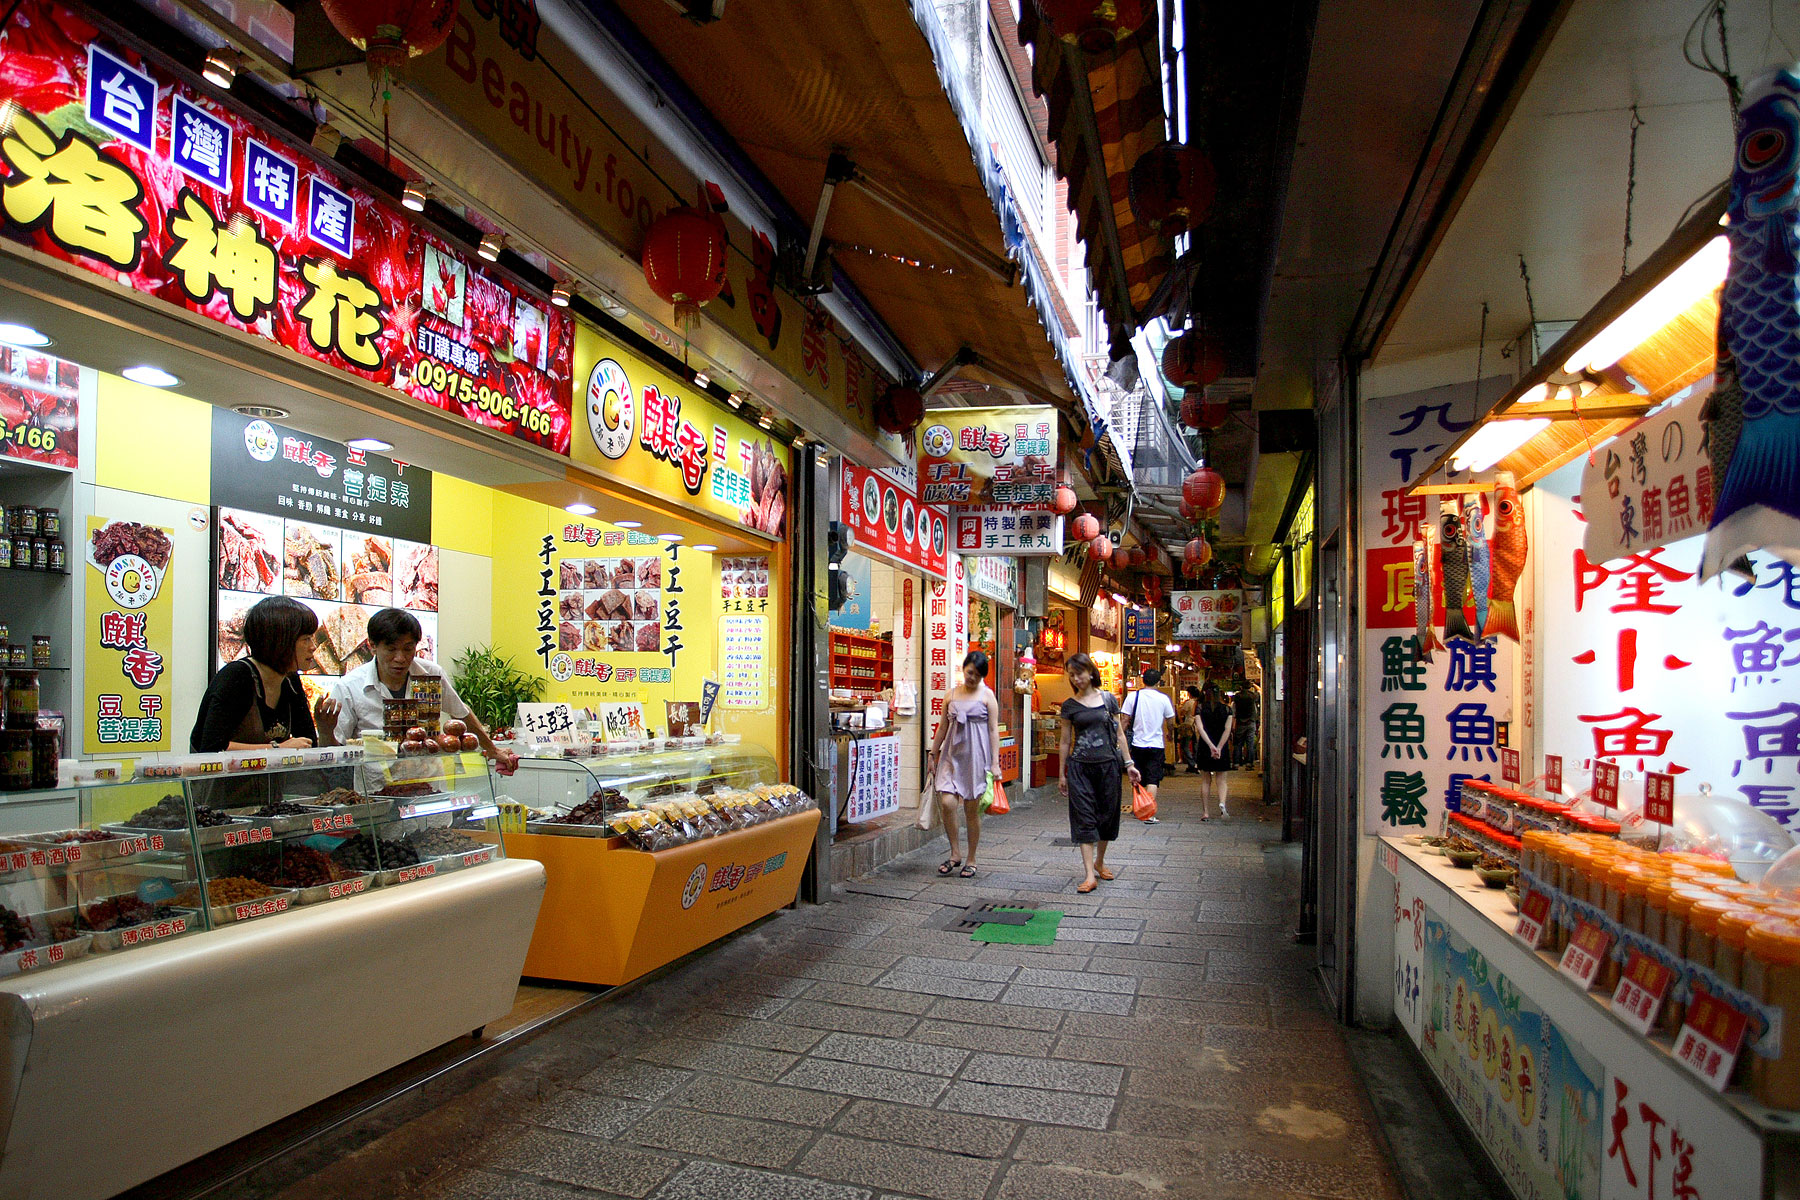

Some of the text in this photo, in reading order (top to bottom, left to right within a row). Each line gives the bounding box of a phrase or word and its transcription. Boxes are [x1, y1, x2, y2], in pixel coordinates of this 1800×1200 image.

[101, 73, 351, 250] 台灣特產
[2, 118, 385, 369] 洛神花
[417, 359, 551, 436] 0915-906-166
[0, 427, 56, 451] -166
[1015, 423, 1049, 440] 豆干
[1015, 439, 1049, 456] 菩提素
[927, 462, 1053, 482] 手工 豆干
[343, 469, 409, 508] 菩提素
[711, 464, 751, 512] 菩提素
[923, 484, 1053, 502] 碳烤 菩提素
[603, 532, 626, 547] 豆干
[961, 520, 977, 547] 阿婆
[985, 534, 1051, 548] 手工魚丸
[536, 535, 558, 671] 手工豆干
[722, 599, 769, 613] 手工豆干
[616, 668, 637, 682] 豆干
[639, 668, 672, 683] 菩提素
[98, 694, 162, 719] 豆干
[98, 717, 162, 743] 菩提素
[1379, 634, 1428, 829] 鮭魚鬆
[1596, 766, 1617, 787] 中辣
[312, 814, 354, 832] 愛文芒果
[119, 834, 165, 856] 小紅莓
[223, 826, 273, 847] 凍頂烏梅
[329, 880, 364, 900] 洛神花
[235, 898, 288, 921] 野生金桔
[122, 919, 187, 946] 薄荷金桔
[21, 945, 65, 970] 茶梅
